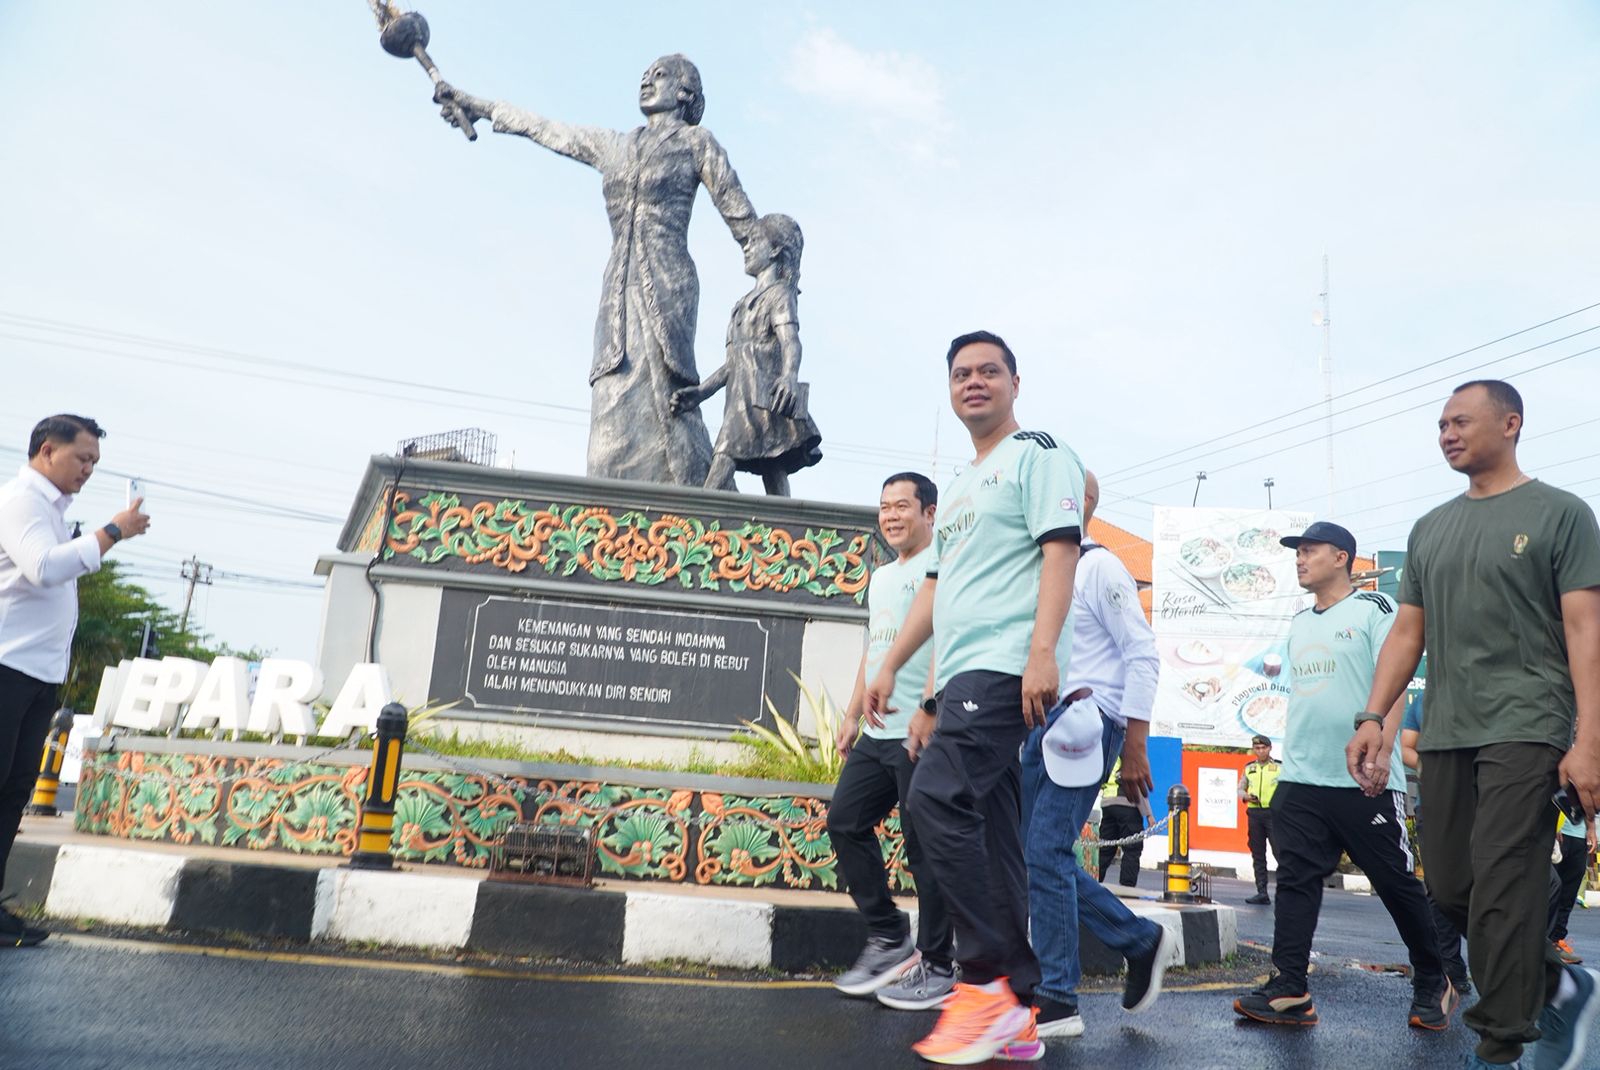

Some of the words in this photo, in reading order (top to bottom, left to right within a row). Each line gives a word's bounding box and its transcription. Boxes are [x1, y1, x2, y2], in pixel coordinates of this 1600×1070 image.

[1162, 592, 1196, 608] Rasa
[518, 618, 592, 639] KEMENANGAN
[596, 625, 621, 642] YANG
[626, 628, 671, 645] SEINDAH
[675, 633, 725, 650] INDAHNYA
[487, 654, 516, 670] OLEH
[520, 657, 567, 675] MANUSIA
[489, 635, 511, 652] DAN
[515, 637, 565, 655] SESUKAR
[569, 642, 624, 660] SUKARNYA
[630, 648, 658, 664] YANG
[660, 650, 696, 667] BOLEH
[700, 653, 711, 667] DI
[714, 655, 750, 671] REBUT
[484, 673, 517, 690] IALAH
[521, 677, 602, 698] MENUNDUKKAN
[606, 686, 626, 700] DIRI
[630, 687, 671, 703] SENDIRI
